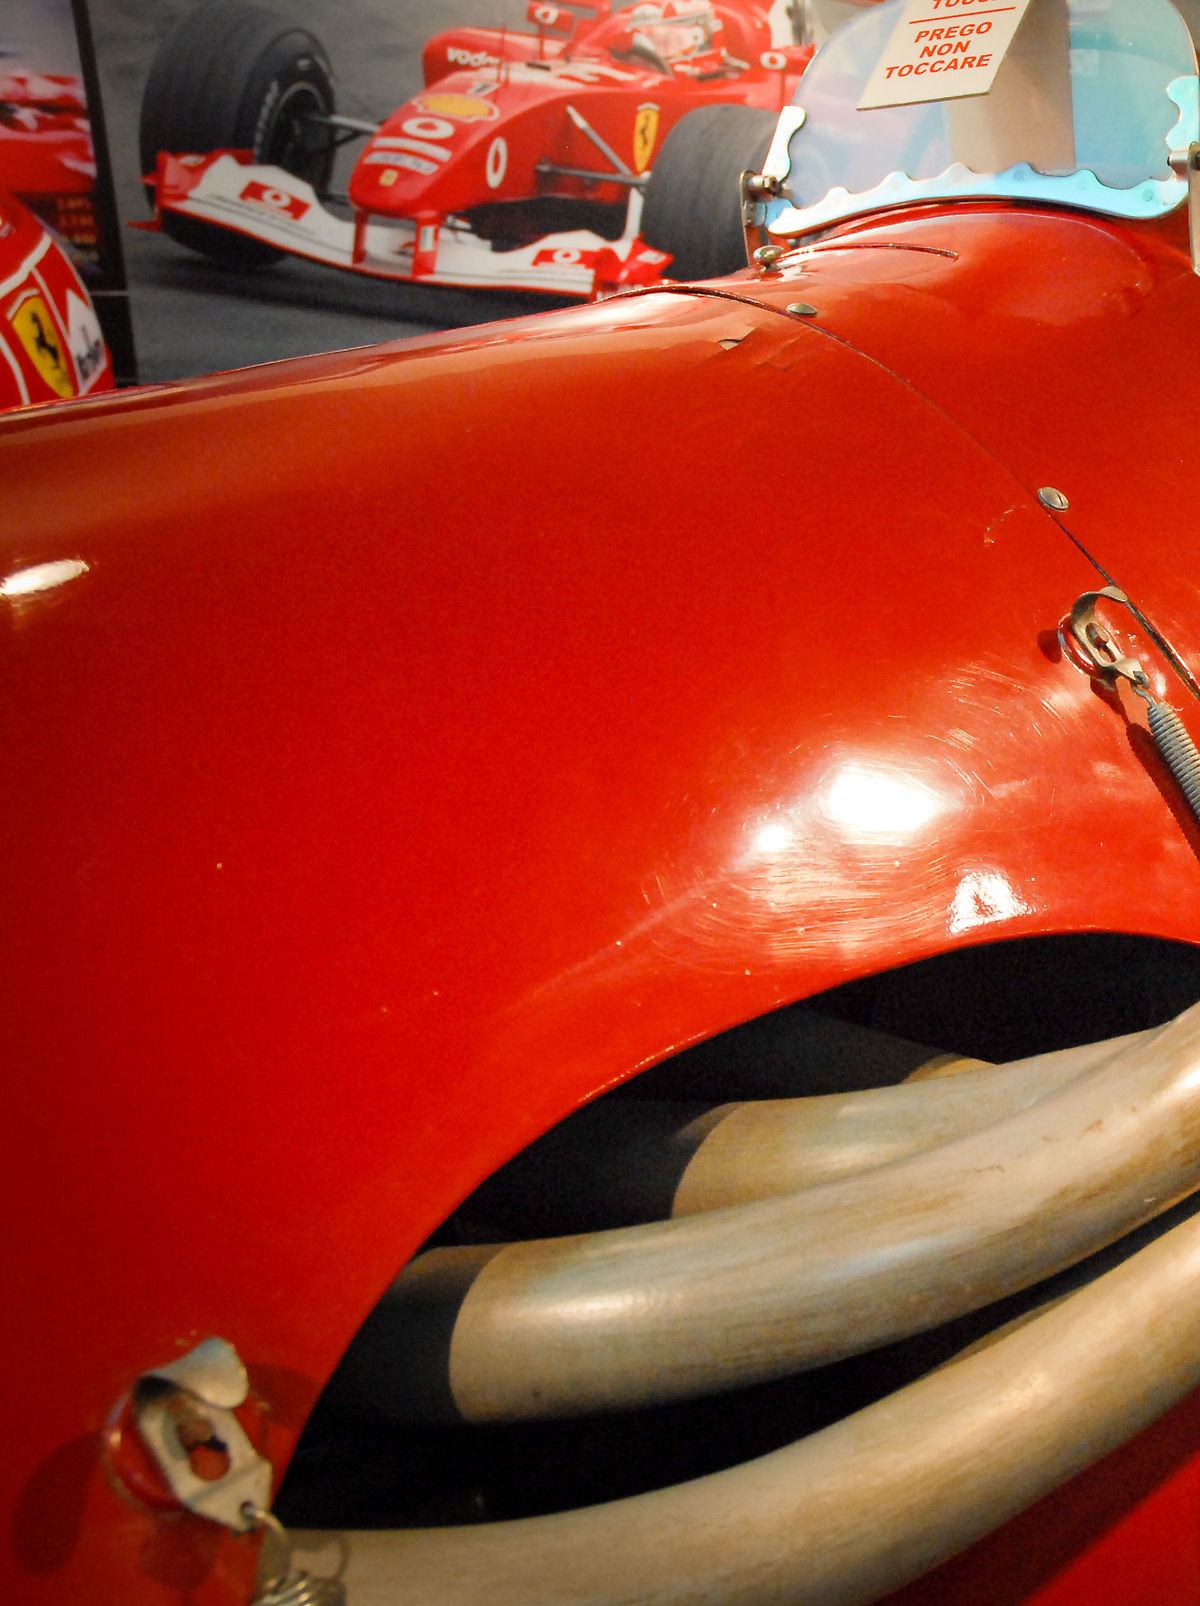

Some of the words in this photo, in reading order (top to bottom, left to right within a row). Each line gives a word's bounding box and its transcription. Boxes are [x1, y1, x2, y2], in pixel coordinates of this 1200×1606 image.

[914, 22, 993, 43] PREGO
[919, 40, 971, 58] NON
[885, 54, 993, 79] TOCCARE
